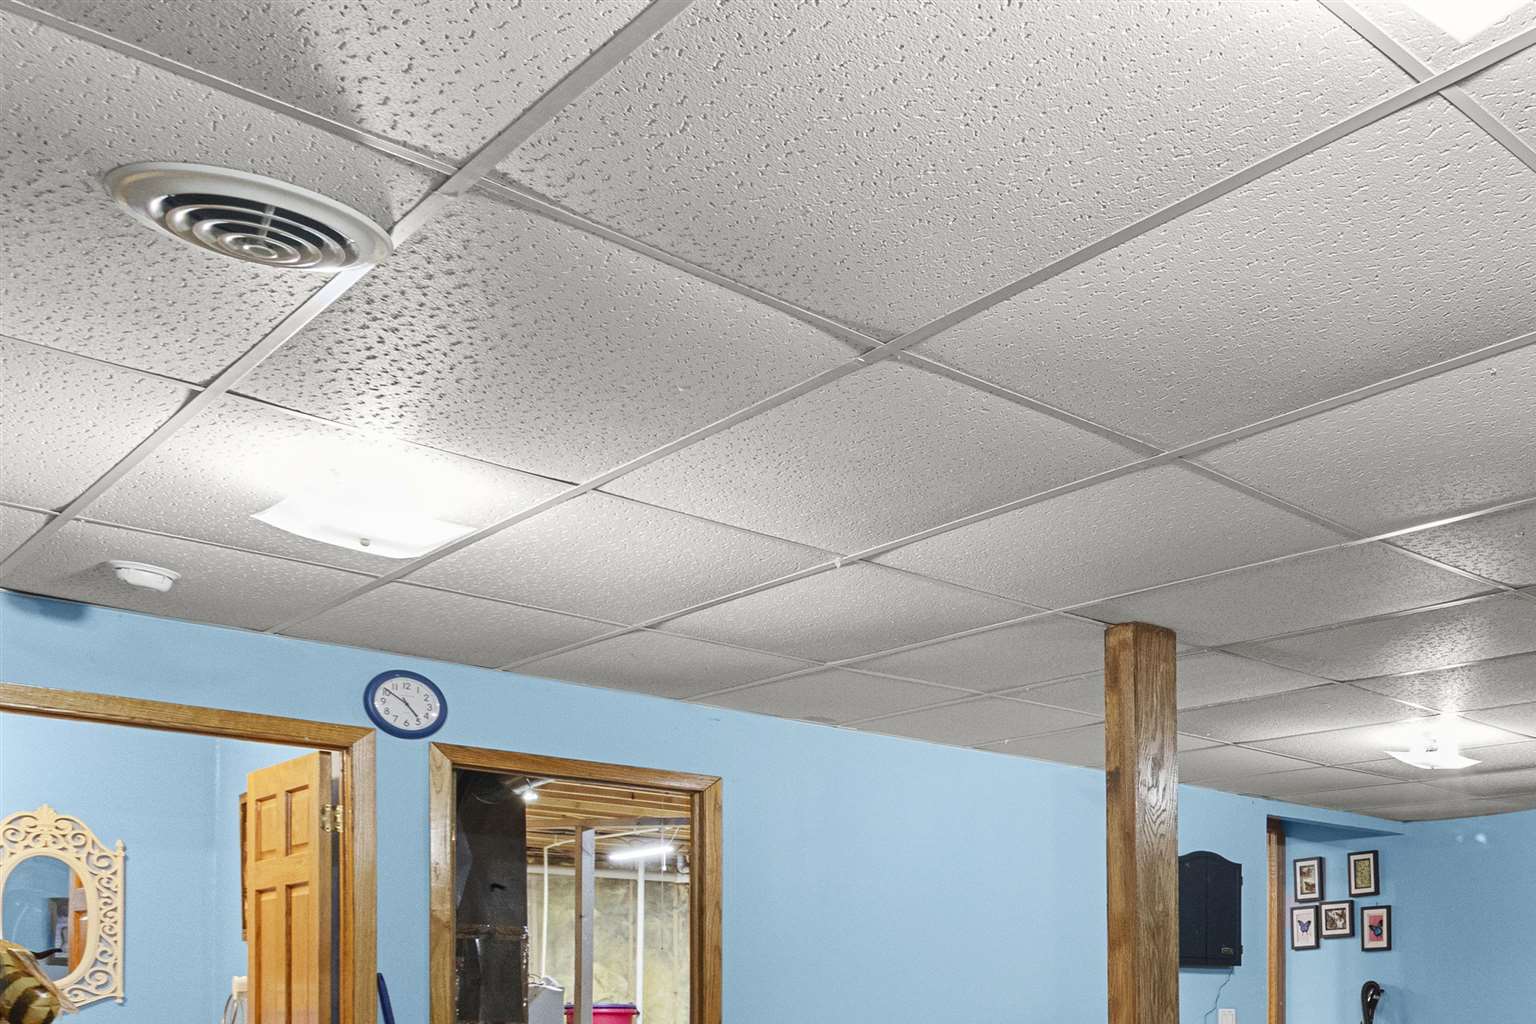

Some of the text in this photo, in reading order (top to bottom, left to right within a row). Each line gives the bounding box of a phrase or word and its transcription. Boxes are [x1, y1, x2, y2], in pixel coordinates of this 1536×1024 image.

[391, 683, 398, 691] 11
[402, 682, 411, 690] 12
[380, 697, 386, 705] 9
[423, 693, 429, 702] 2
[384, 707, 390, 715] 8
[426, 703, 433, 711] 3
[392, 714, 399, 722] 7
[423, 712, 429, 720] 4
